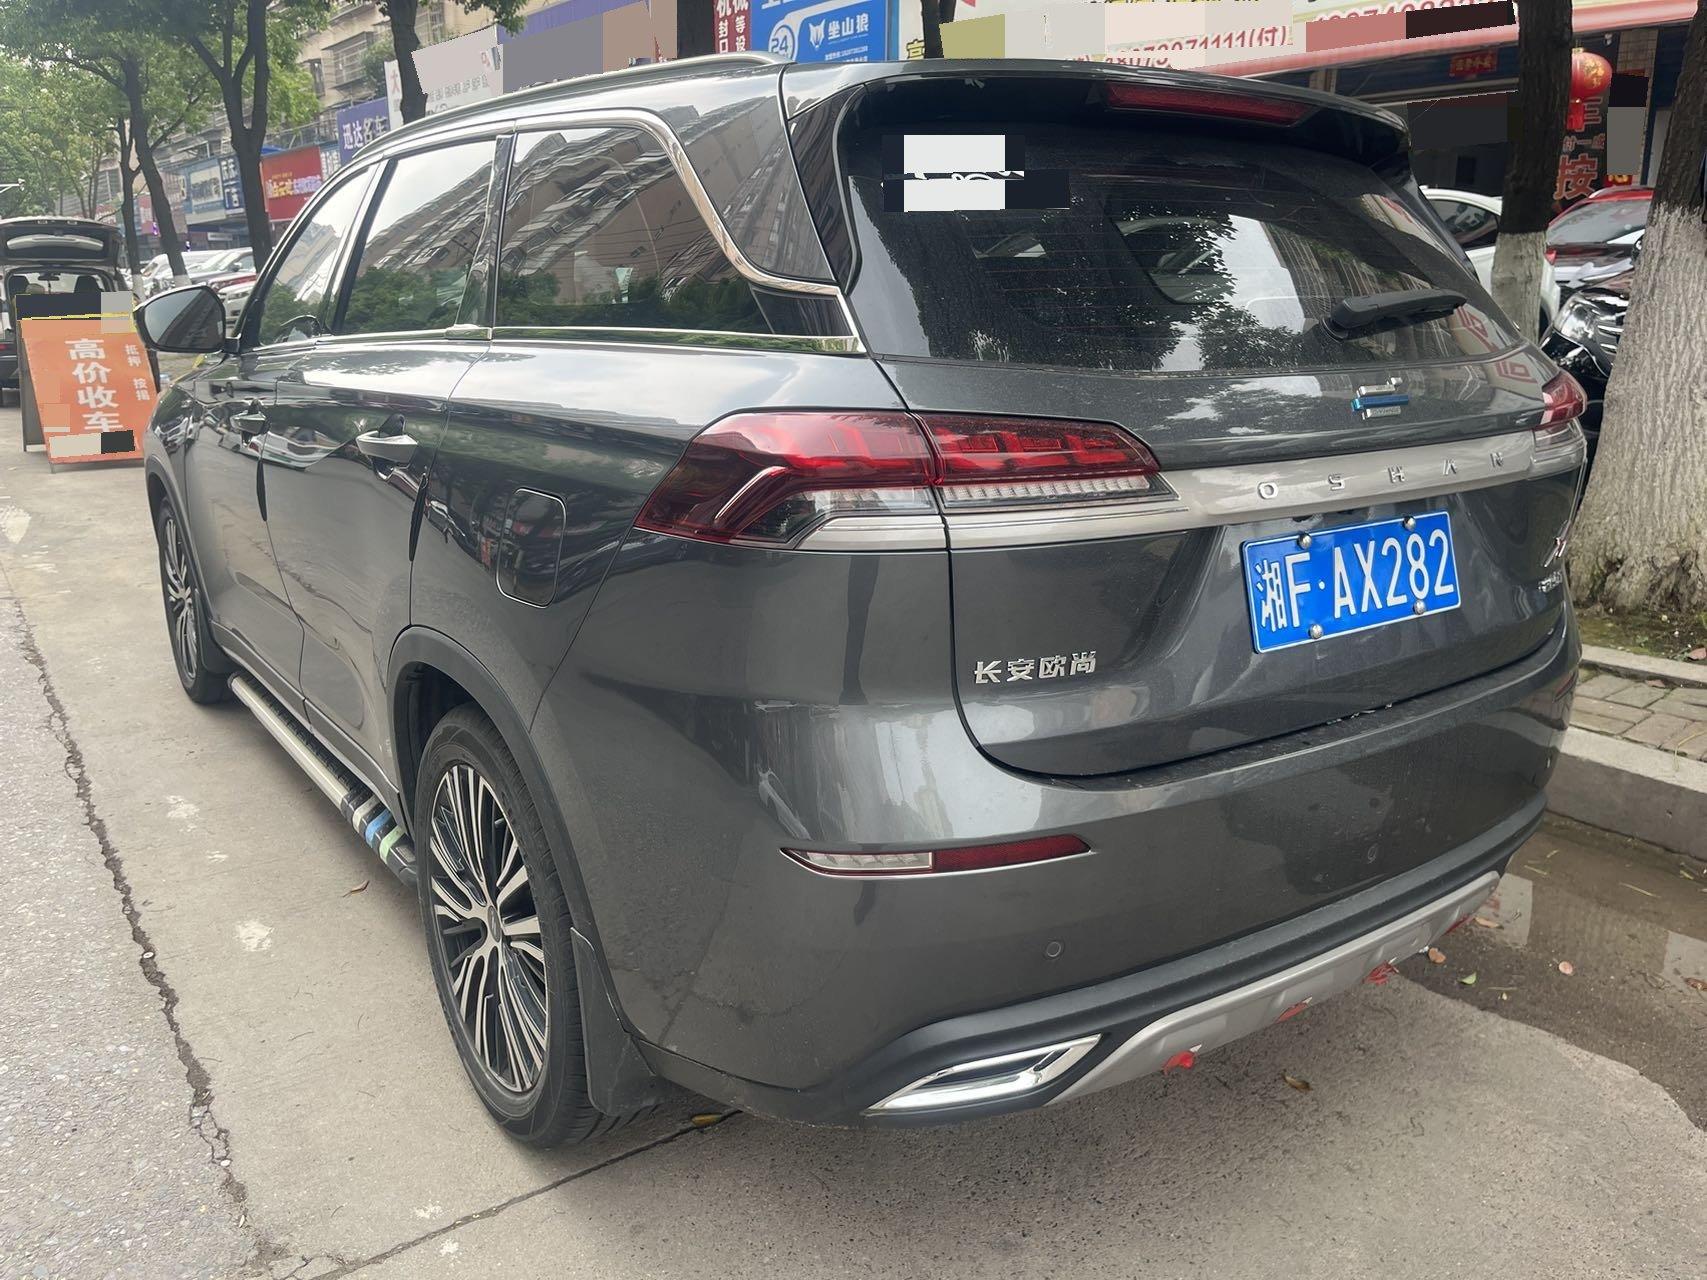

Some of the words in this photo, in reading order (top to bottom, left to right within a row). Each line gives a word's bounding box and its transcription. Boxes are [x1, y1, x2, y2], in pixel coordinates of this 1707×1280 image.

[828, 13, 869, 40] 坐山狼
[771, 36, 789, 54] 24
[65, 338, 123, 432] 高价收车
[1258, 452, 1504, 499] OSHAN
[974, 651, 1096, 683] 长安欧尚
